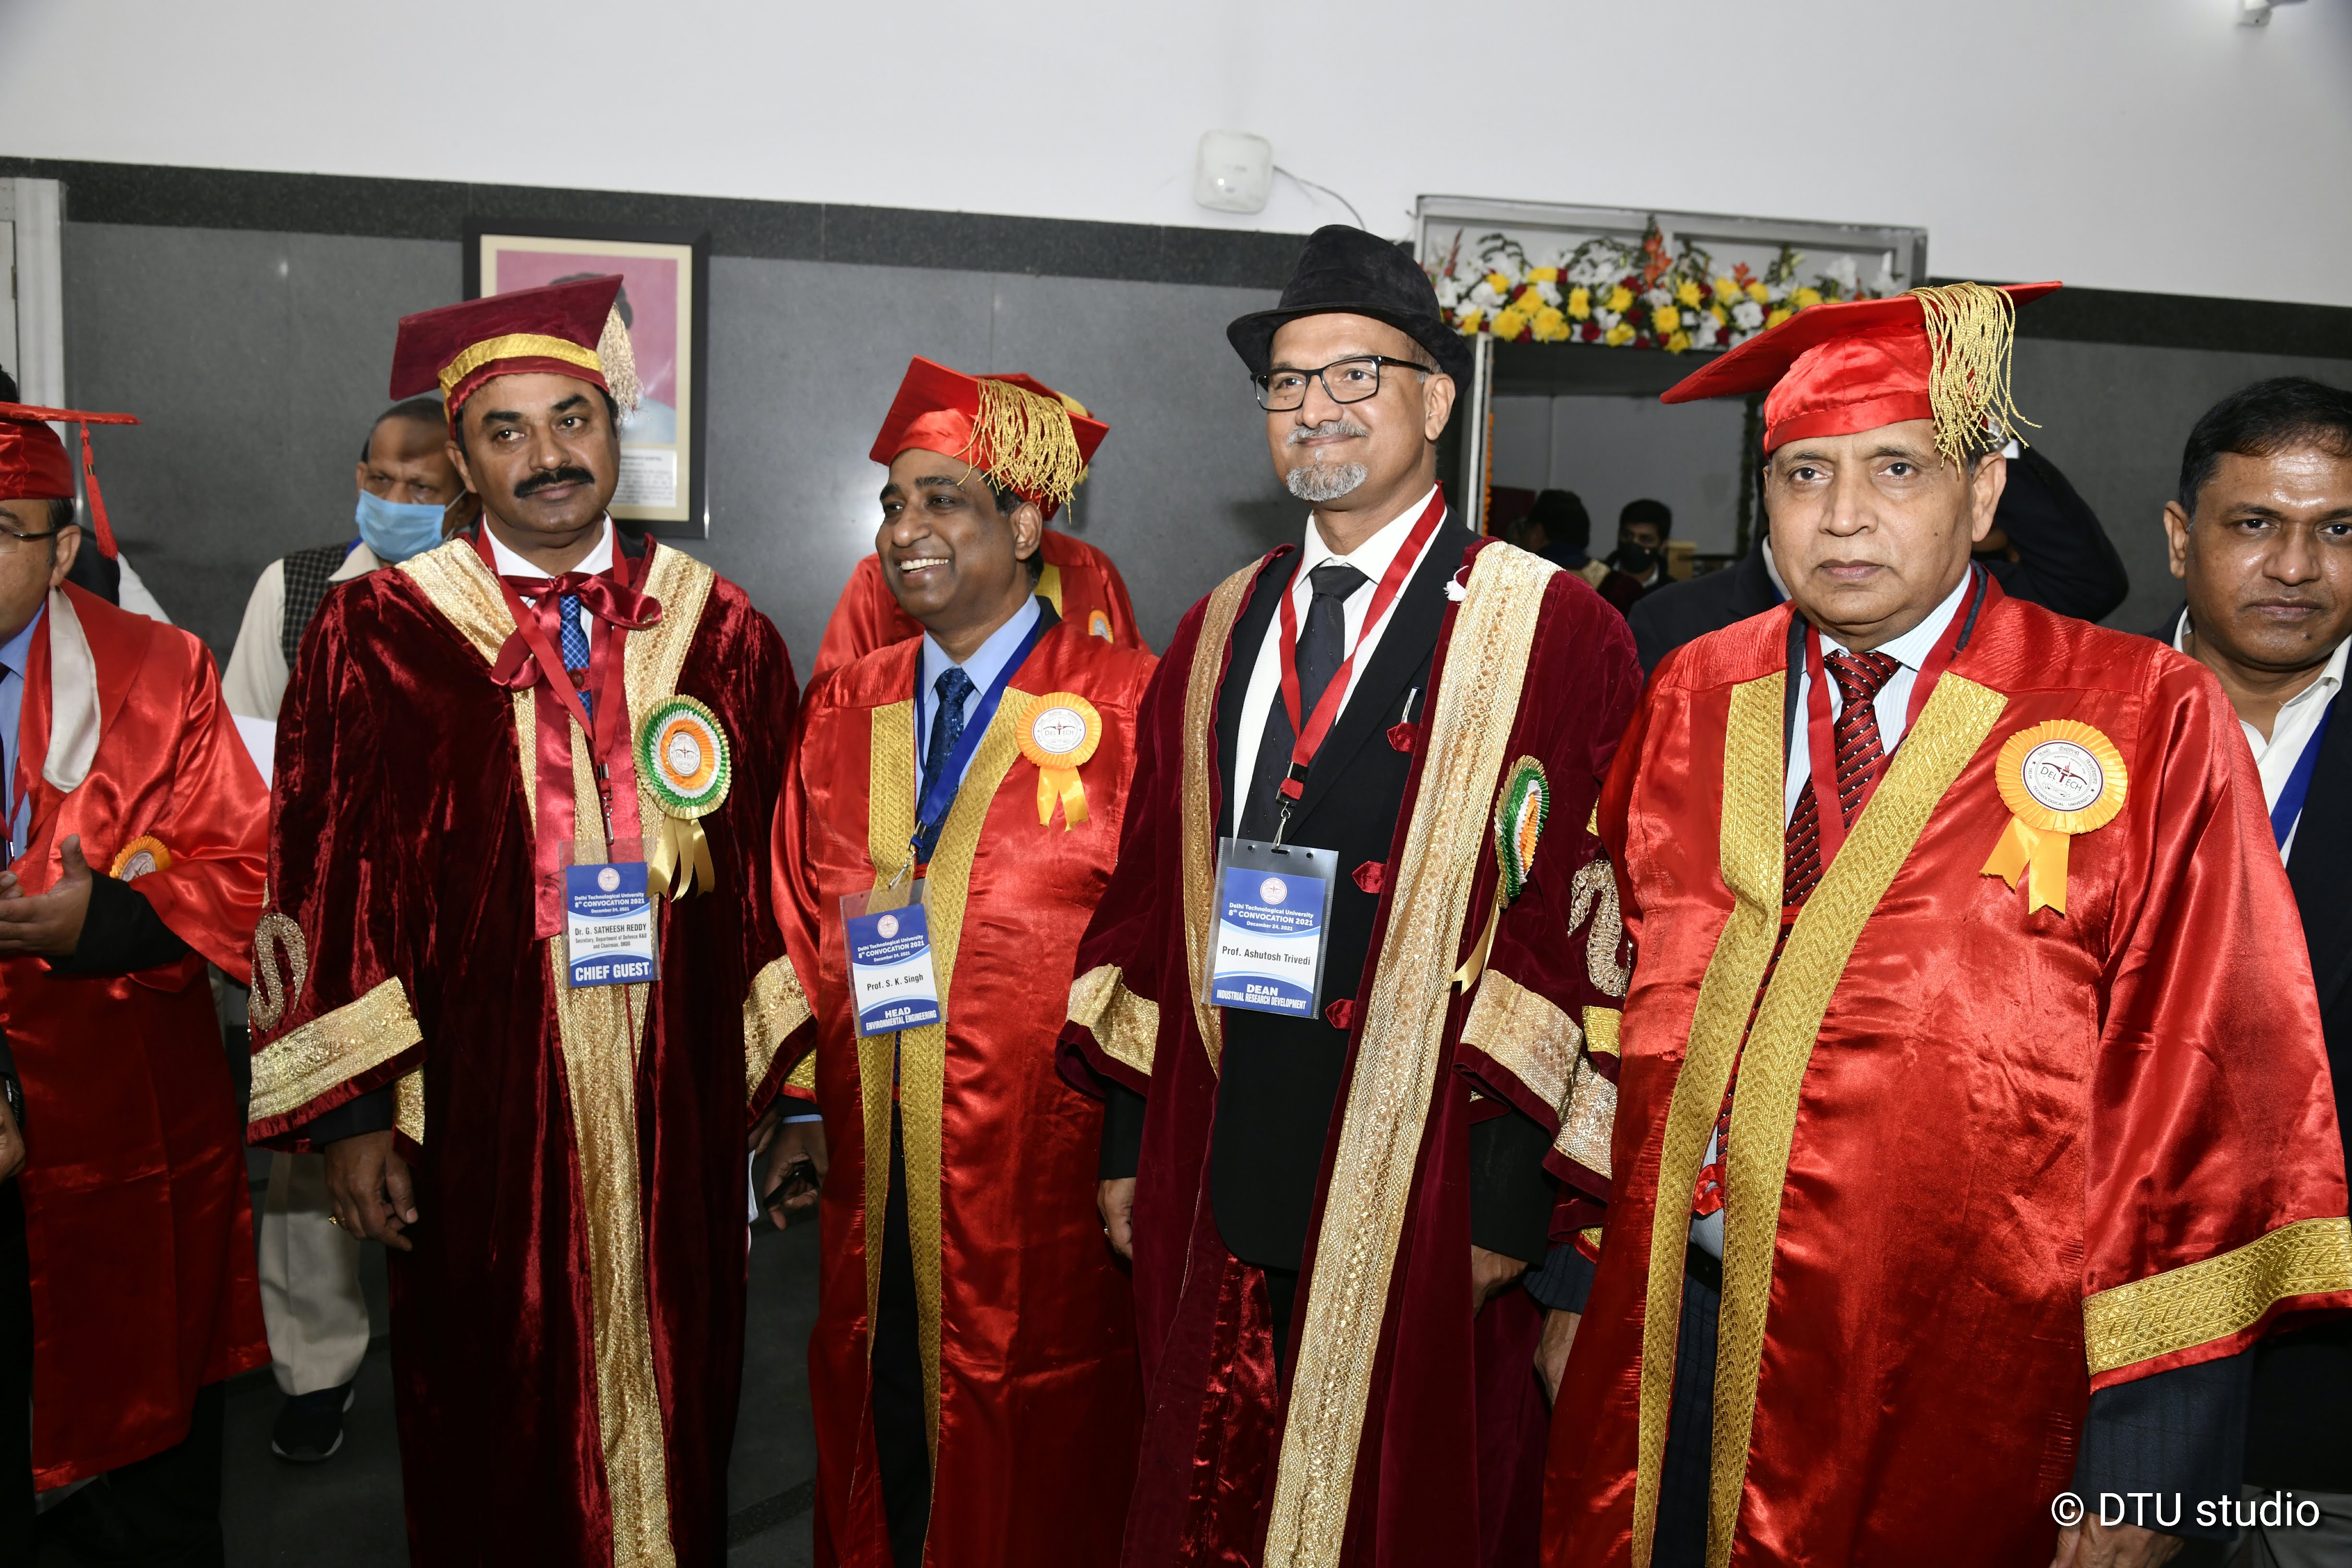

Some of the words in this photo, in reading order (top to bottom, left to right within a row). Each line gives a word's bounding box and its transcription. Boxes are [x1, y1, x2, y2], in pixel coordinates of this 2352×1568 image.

[2037, 749, 2050, 757] दिल्ली
[2041, 766, 2082, 791] DELTECH
[2033, 785, 2064, 806] TECHNOLOGICAL
[2068, 795, 2091, 807] UNIVERSITY
[583, 899, 629, 907] CONVOCATION
[1238, 911, 1294, 924] CONVOCATION
[1245, 904, 1284, 914] Technological
[1285, 910, 1314, 919] University
[594, 925, 625, 934] SATHEESH
[866, 943, 909, 957] CONVOCATION
[869, 939, 900, 948] Technological
[1222, 946, 1241, 956] Prof.
[1244, 949, 1281, 961] Ashutosh
[1284, 954, 1310, 965] Trivedi
[575, 965, 610, 981] CHIEF
[613, 962, 649, 978] GUEST
[867, 982, 884, 991] Prof.
[904, 973, 923, 983] Singh
[1247, 984, 1278, 996] DEAN
[1217, 989, 1244, 1001] INDUSTRIAL
[1245, 993, 1270, 1004] RESEARCH
[1271, 997, 1306, 1009] DEVELOPMENT
[885, 1007, 911, 1018] HEAD
[866, 1016, 905, 1031] ENVIRONMENTAL
[905, 1010, 937, 1023] ENGINEERING
